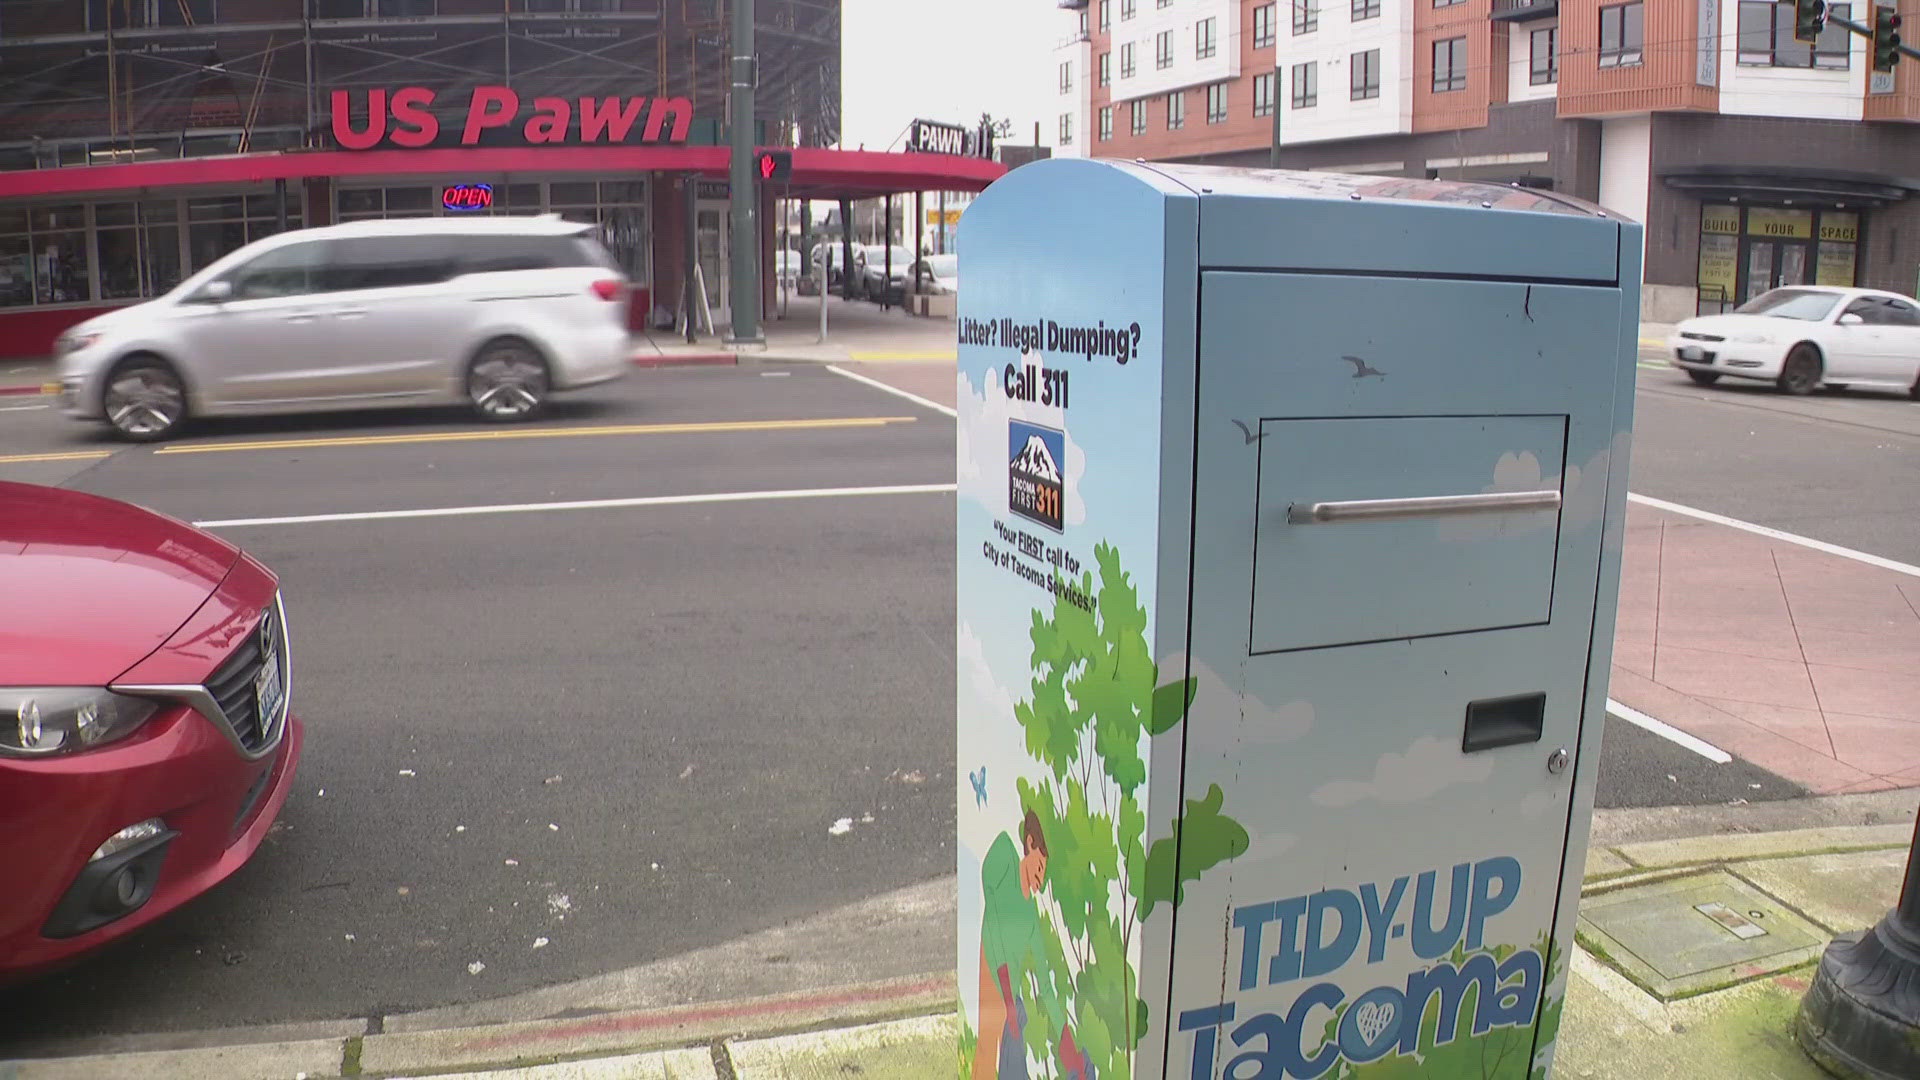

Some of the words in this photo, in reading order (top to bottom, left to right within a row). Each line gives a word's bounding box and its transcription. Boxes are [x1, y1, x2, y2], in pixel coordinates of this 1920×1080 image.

[330, 87, 439, 150] US
[461, 86, 694, 144] Pawn
[919, 123, 963, 156] PAWN
[443, 187, 492, 207] OPEN
[1703, 219, 1738, 232] BUILD
[1764, 222, 1795, 235] YOUR
[1820, 226, 1856, 240] SPACE
[957, 317, 997, 346] Litter?
[1001, 318, 1044, 354] Illegal
[1047, 320, 1141, 365] Dumping?
[1004, 363, 1037, 402] Call
[1041, 367, 1069, 409] 311
[1012, 476, 1036, 496] TACOMA
[1012, 488, 1036, 510] FIRST
[1036, 482, 1060, 520] 311
[983, 540, 999, 567] City
[1000, 551, 1011, 568] of
[1011, 555, 1046, 589] Tacoma
[1018, 530, 1044, 562] FIRST
[1046, 547, 1063, 569] call
[1065, 551, 1080, 576] for
[1233, 856, 1522, 991] TIDY-UP
